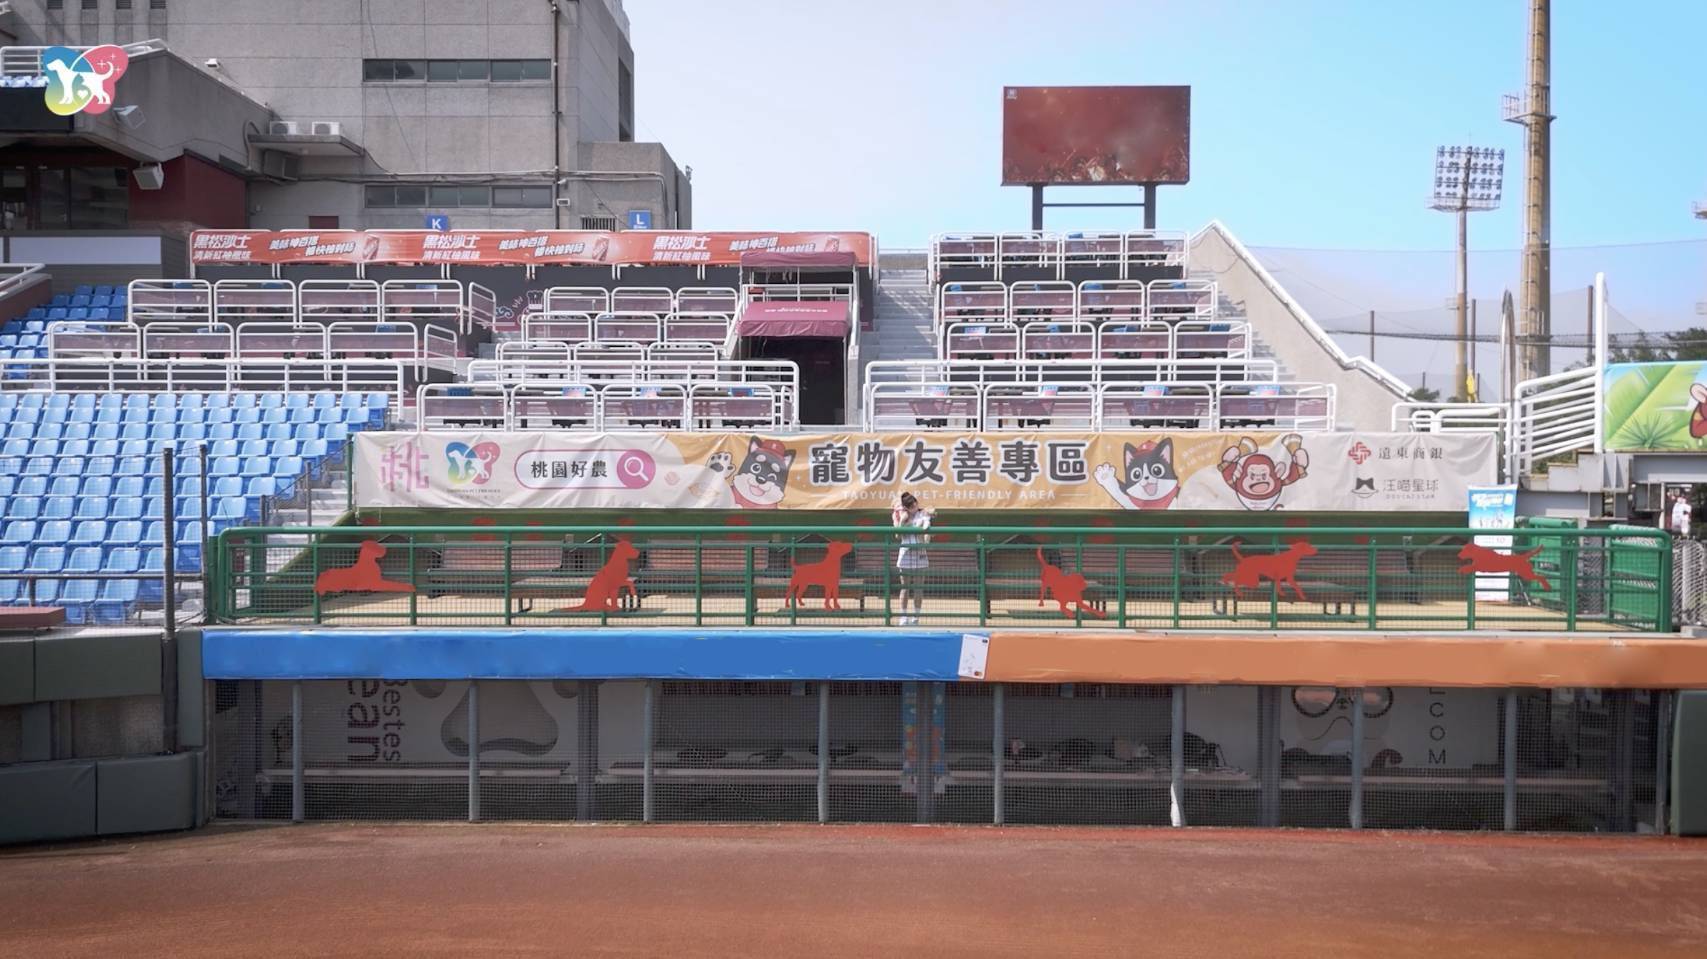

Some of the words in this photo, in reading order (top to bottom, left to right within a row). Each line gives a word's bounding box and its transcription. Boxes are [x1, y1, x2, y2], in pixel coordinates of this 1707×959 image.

[431, 218, 442, 229] K
[636, 213, 645, 225] L
[193, 234, 252, 249] 黑松沙士
[422, 234, 481, 249] 黑松沙士
[652, 235, 712, 250] 黑松沙士
[1378, 446, 1443, 460] 遠東商銀
[530, 460, 608, 479] 桃園好農
[811, 440, 1088, 484] 寵物友善專區
[1382, 478, 1440, 493] 汪喵星球
[915, 490, 1013, 500] PET-FRIENDLY
[1019, 490, 1056, 500] AREA
